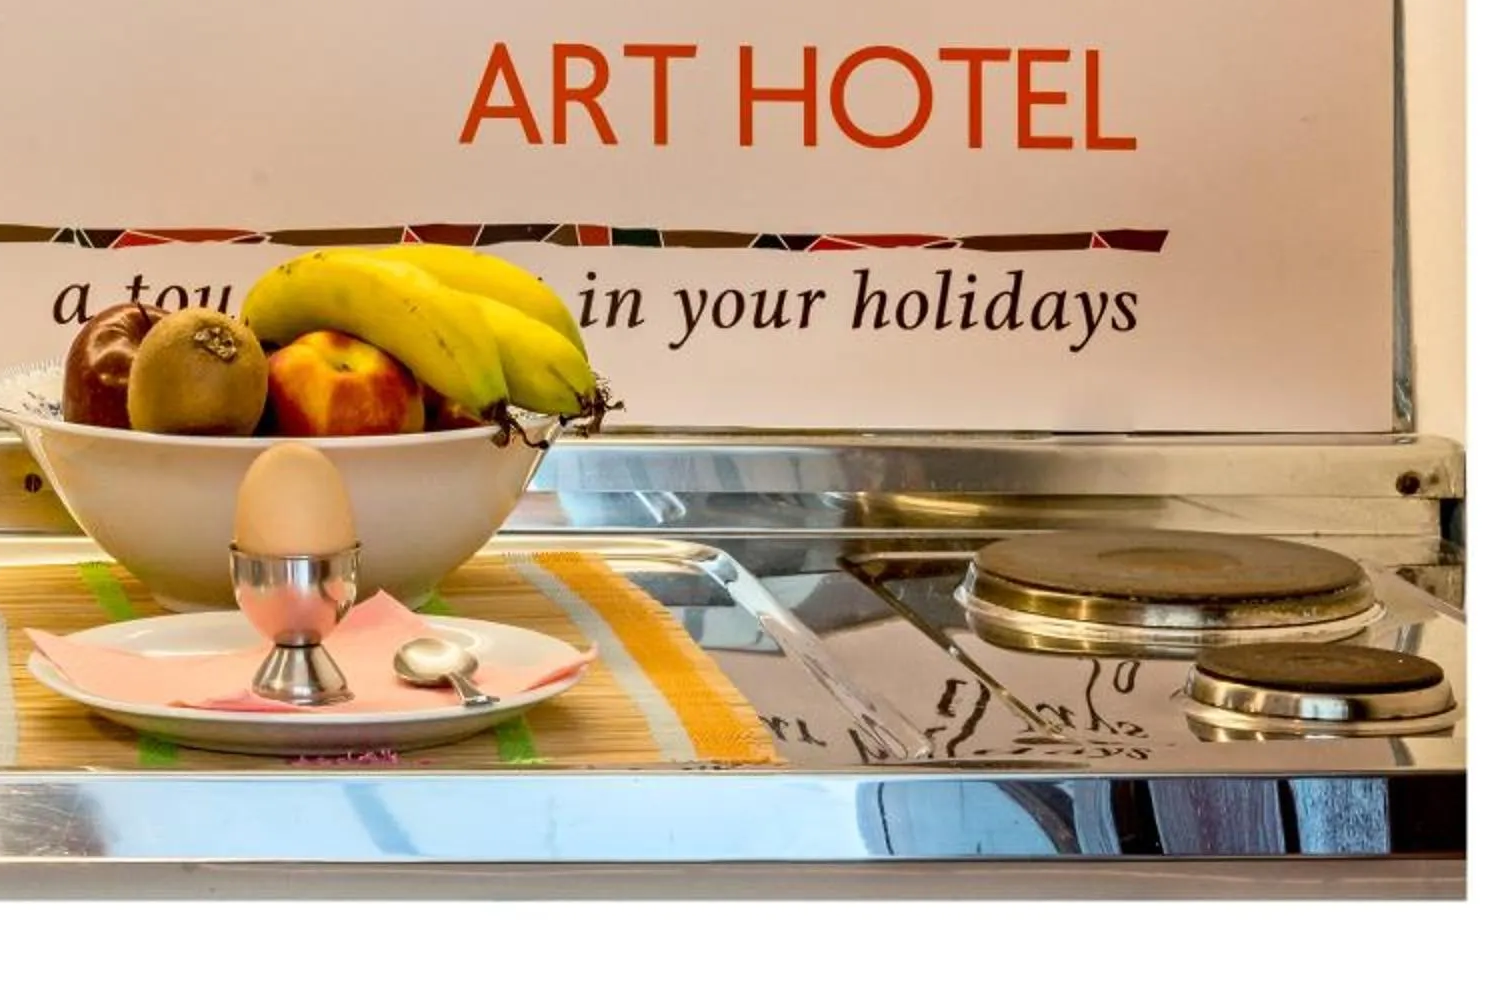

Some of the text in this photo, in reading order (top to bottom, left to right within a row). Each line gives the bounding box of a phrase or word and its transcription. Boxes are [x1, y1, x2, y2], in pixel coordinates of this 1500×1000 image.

[458, 42, 1138, 151] ART HOTEL
[52, 267, 1139, 354] a tou in your holidays
